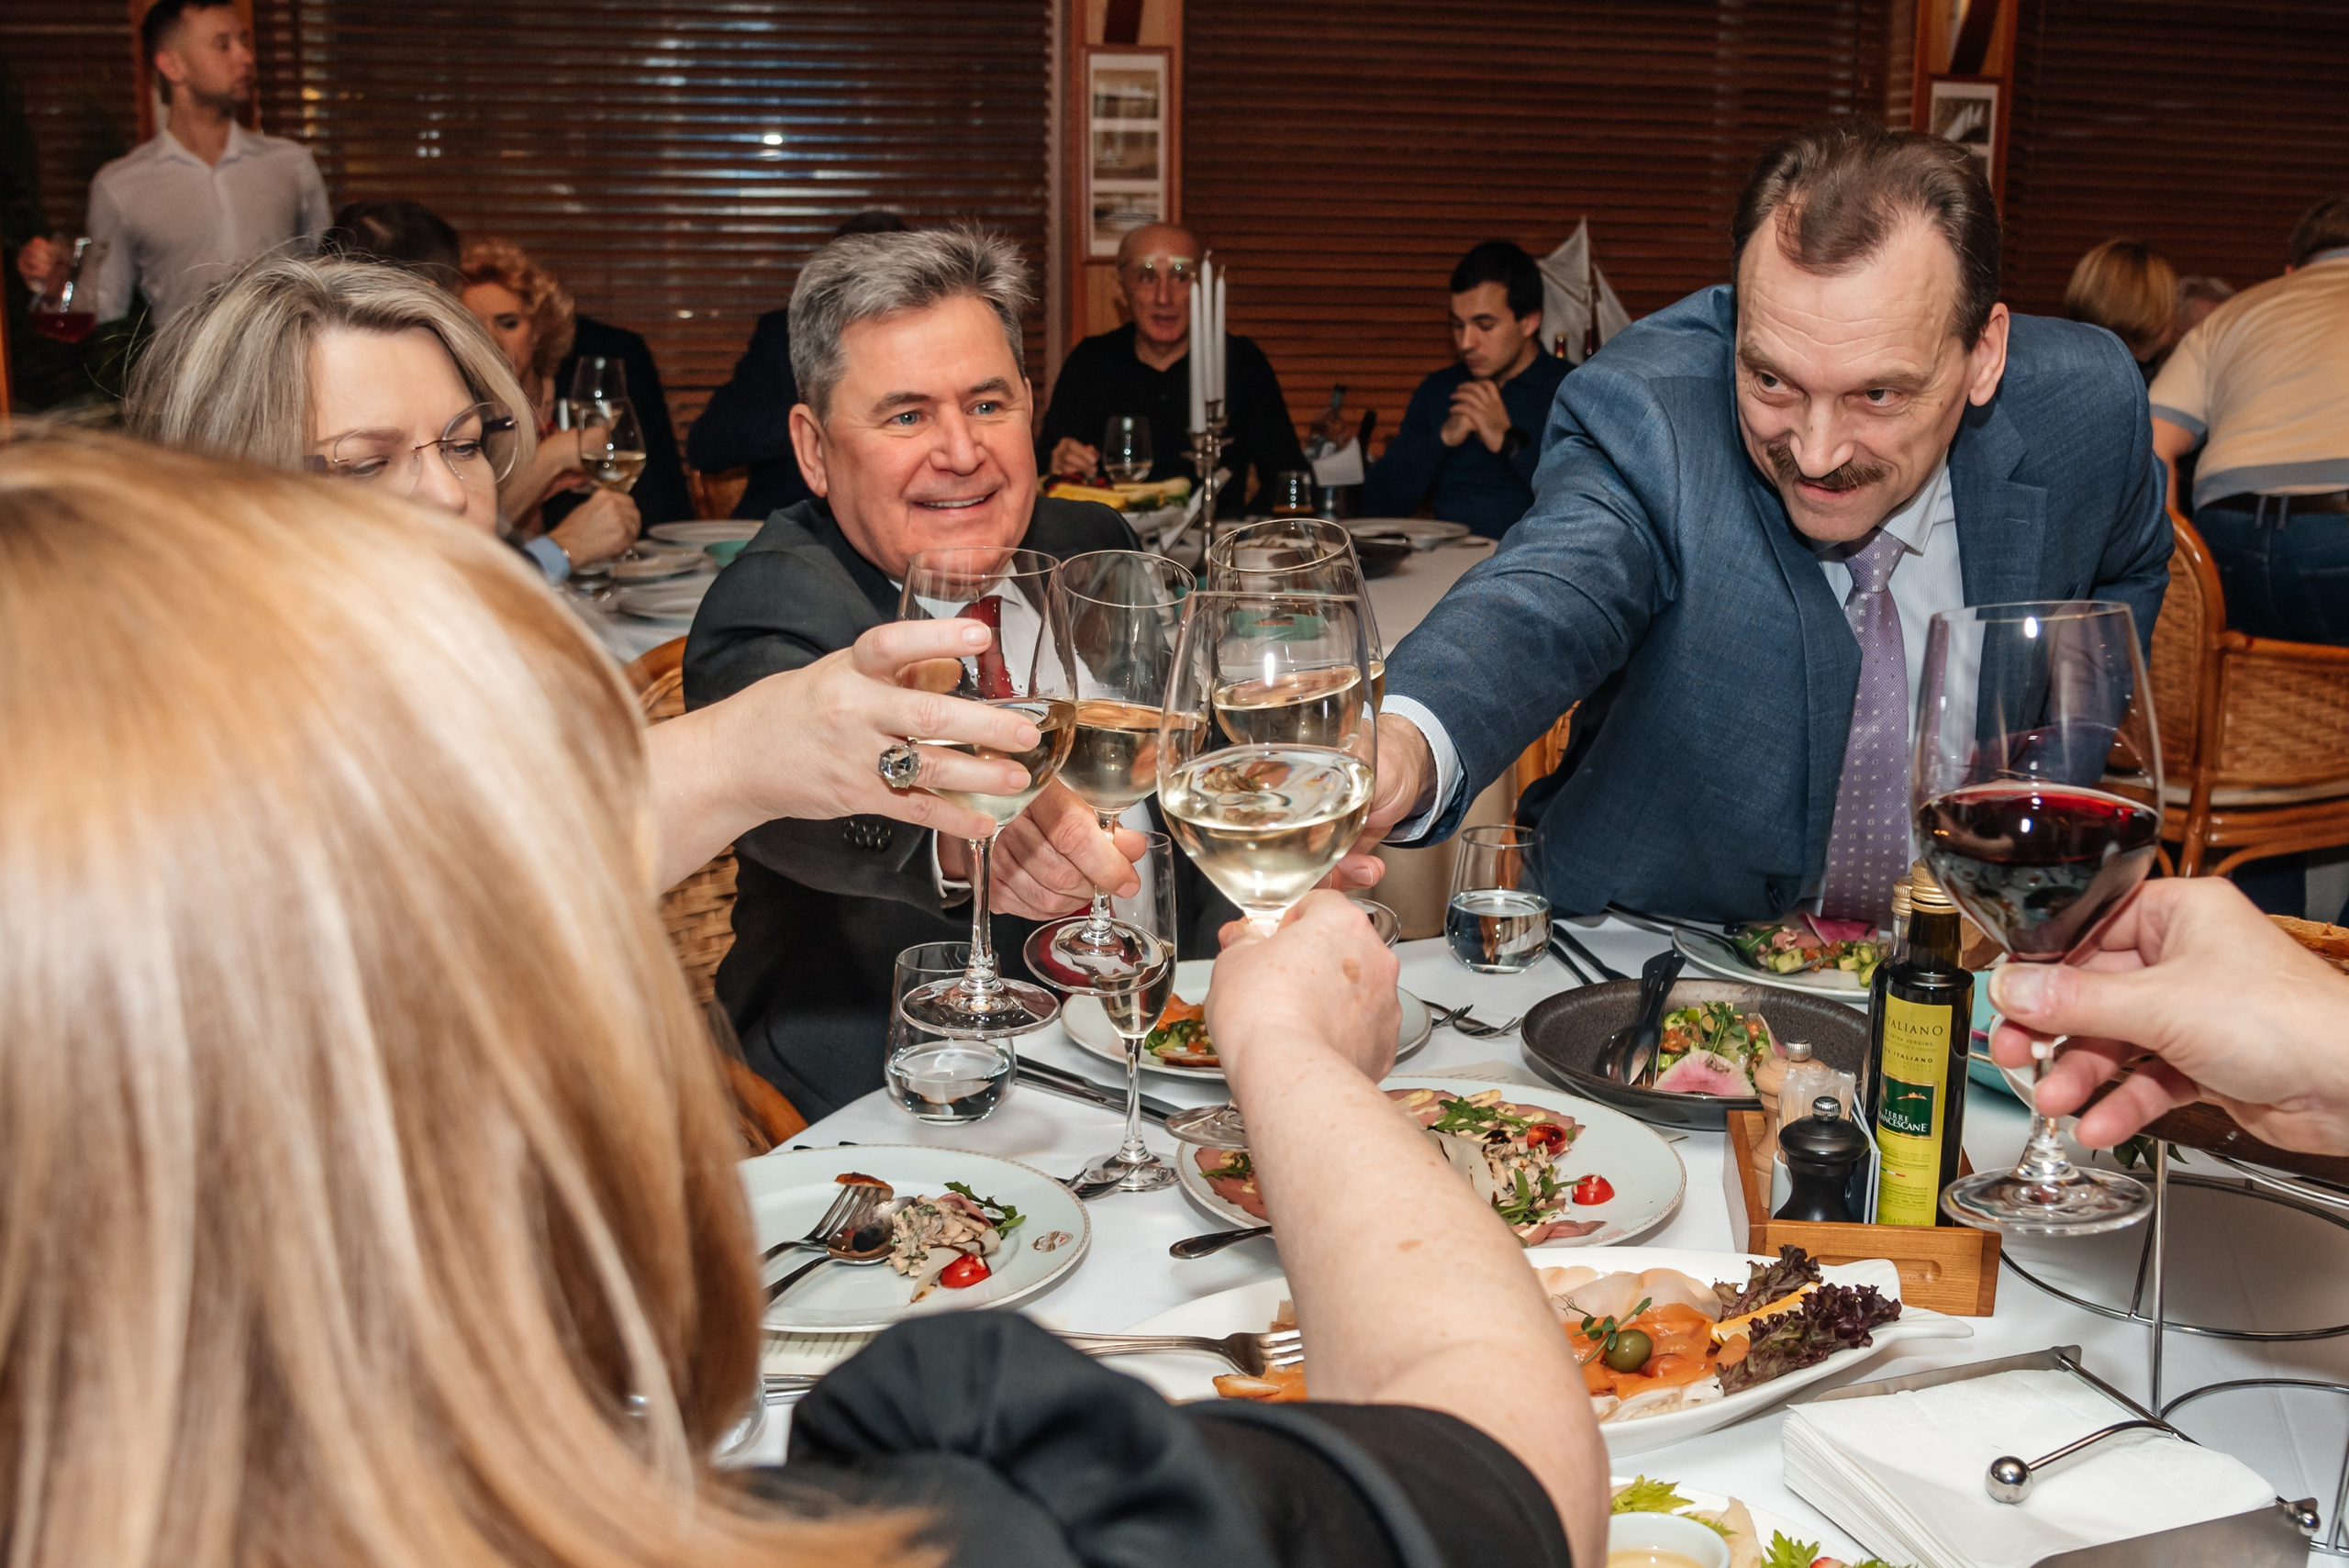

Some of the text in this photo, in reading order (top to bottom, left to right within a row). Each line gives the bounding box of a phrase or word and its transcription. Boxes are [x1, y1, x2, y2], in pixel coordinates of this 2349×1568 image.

[1887, 1017, 1943, 1037] TALIANO
[1893, 1051, 1933, 1063] ITALIANO
[1885, 1108, 1909, 1123] TERRE
